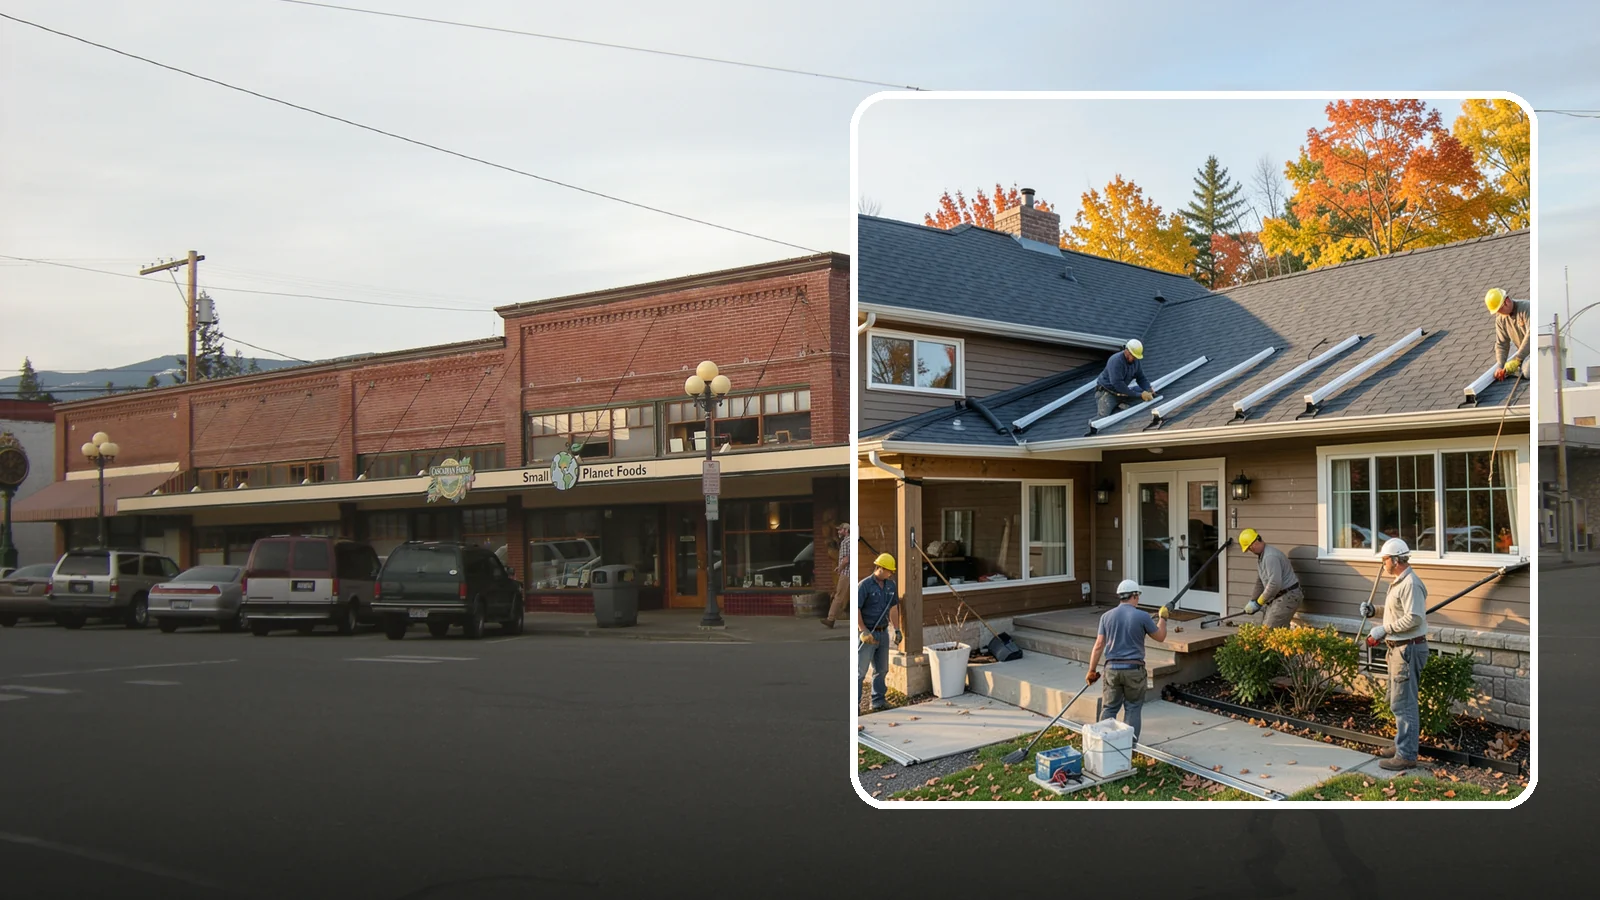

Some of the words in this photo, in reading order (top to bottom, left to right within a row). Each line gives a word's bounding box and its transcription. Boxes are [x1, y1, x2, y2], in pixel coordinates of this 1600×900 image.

[523, 471, 549, 483] Small
[583, 465, 614, 479] Planet
[617, 464, 647, 477] Foods
